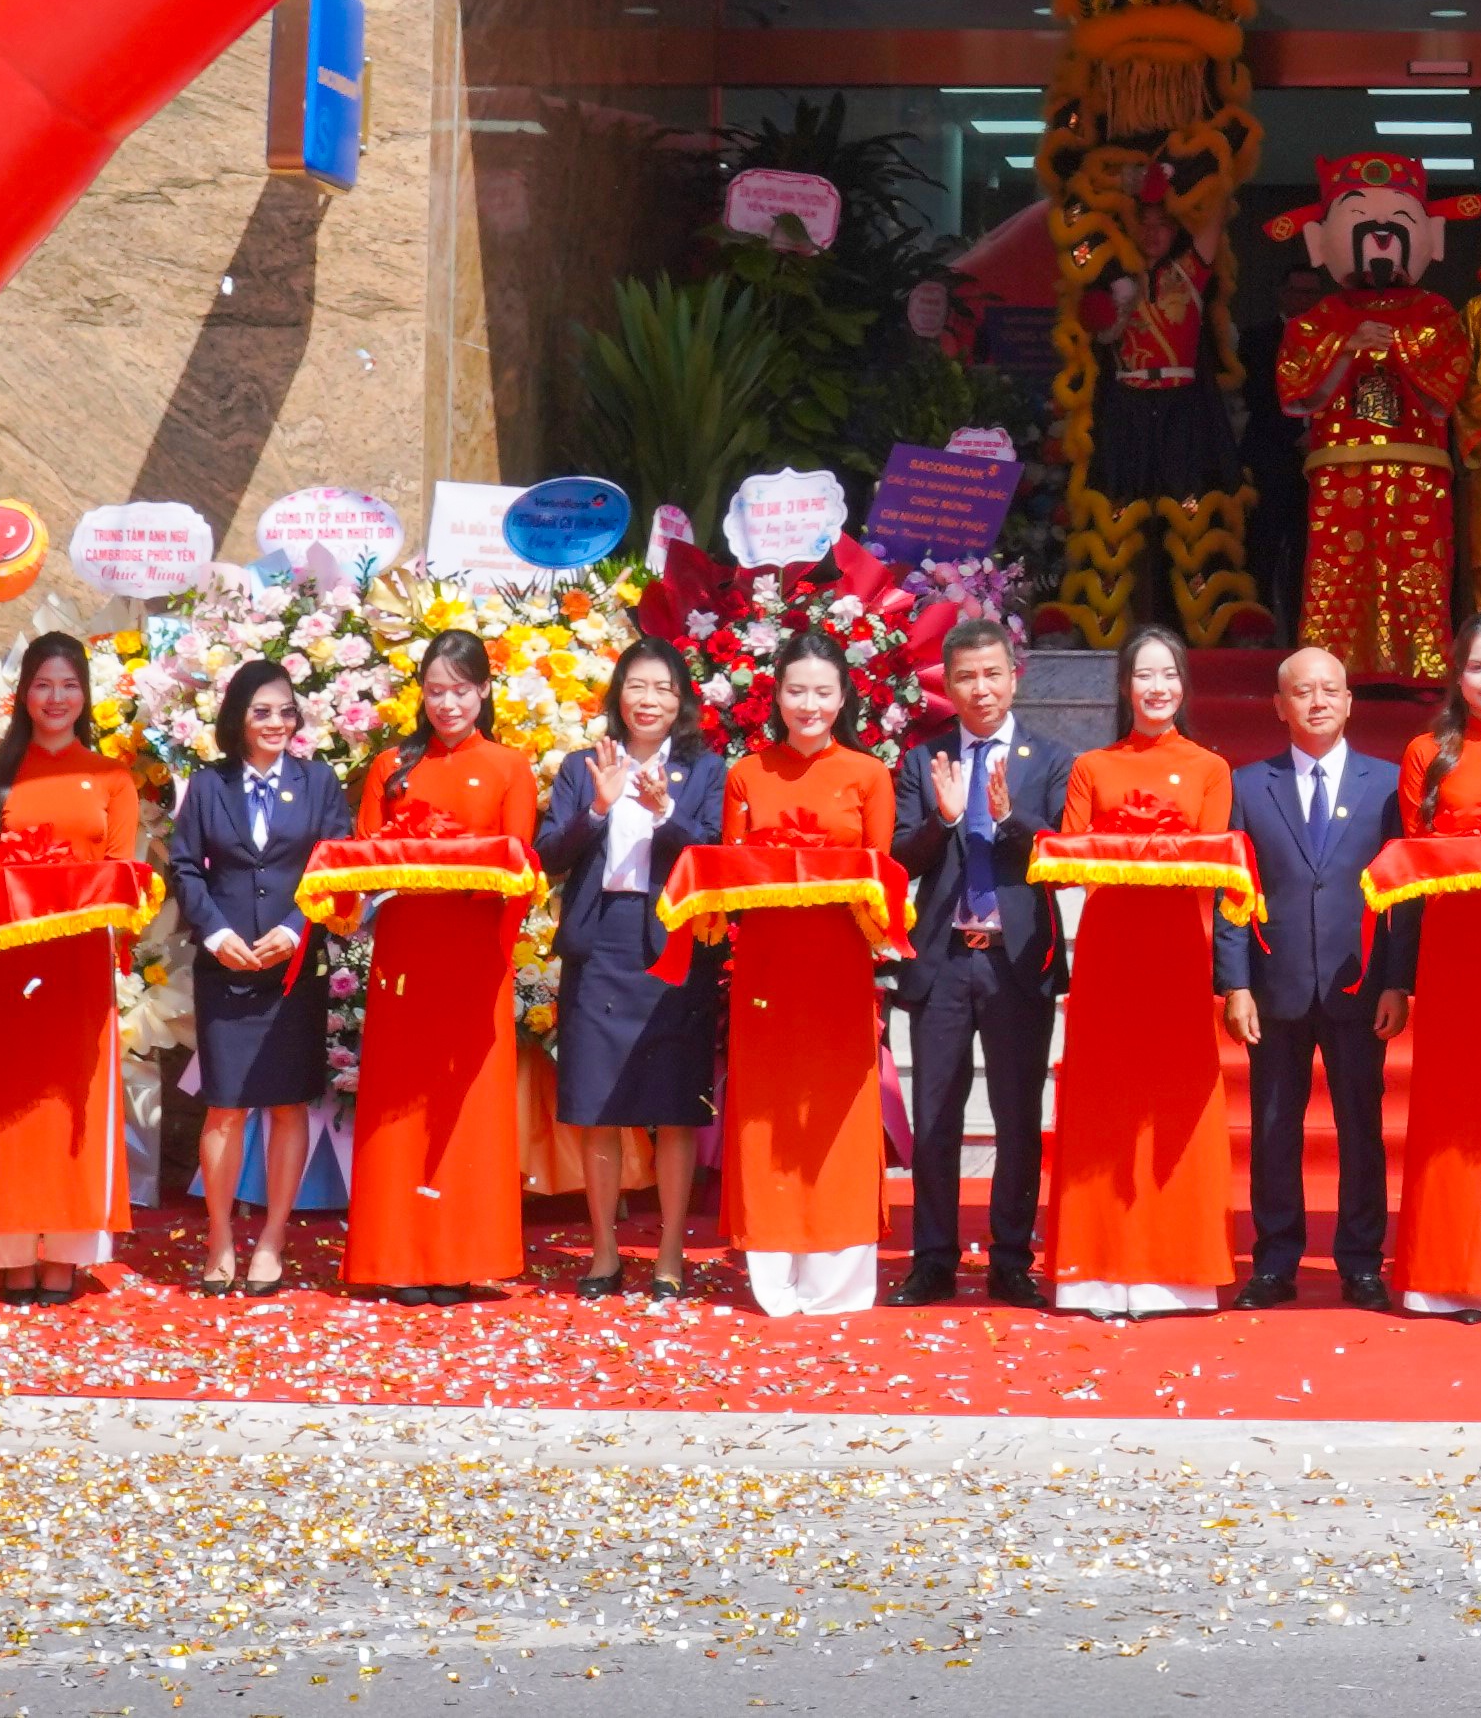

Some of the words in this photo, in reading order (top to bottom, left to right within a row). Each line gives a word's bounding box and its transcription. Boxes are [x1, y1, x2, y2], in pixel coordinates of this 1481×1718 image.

[909, 458, 985, 480] SACOMBANK
[275, 509, 300, 523] CÔNG
[305, 512, 315, 523] TY
[94, 529, 123, 542] TRUNG
[127, 527, 145, 542] TÂM
[148, 529, 166, 542] ANH
[85, 549, 143, 562] CAMBRIDGE
[147, 547, 173, 562] PHÚC
